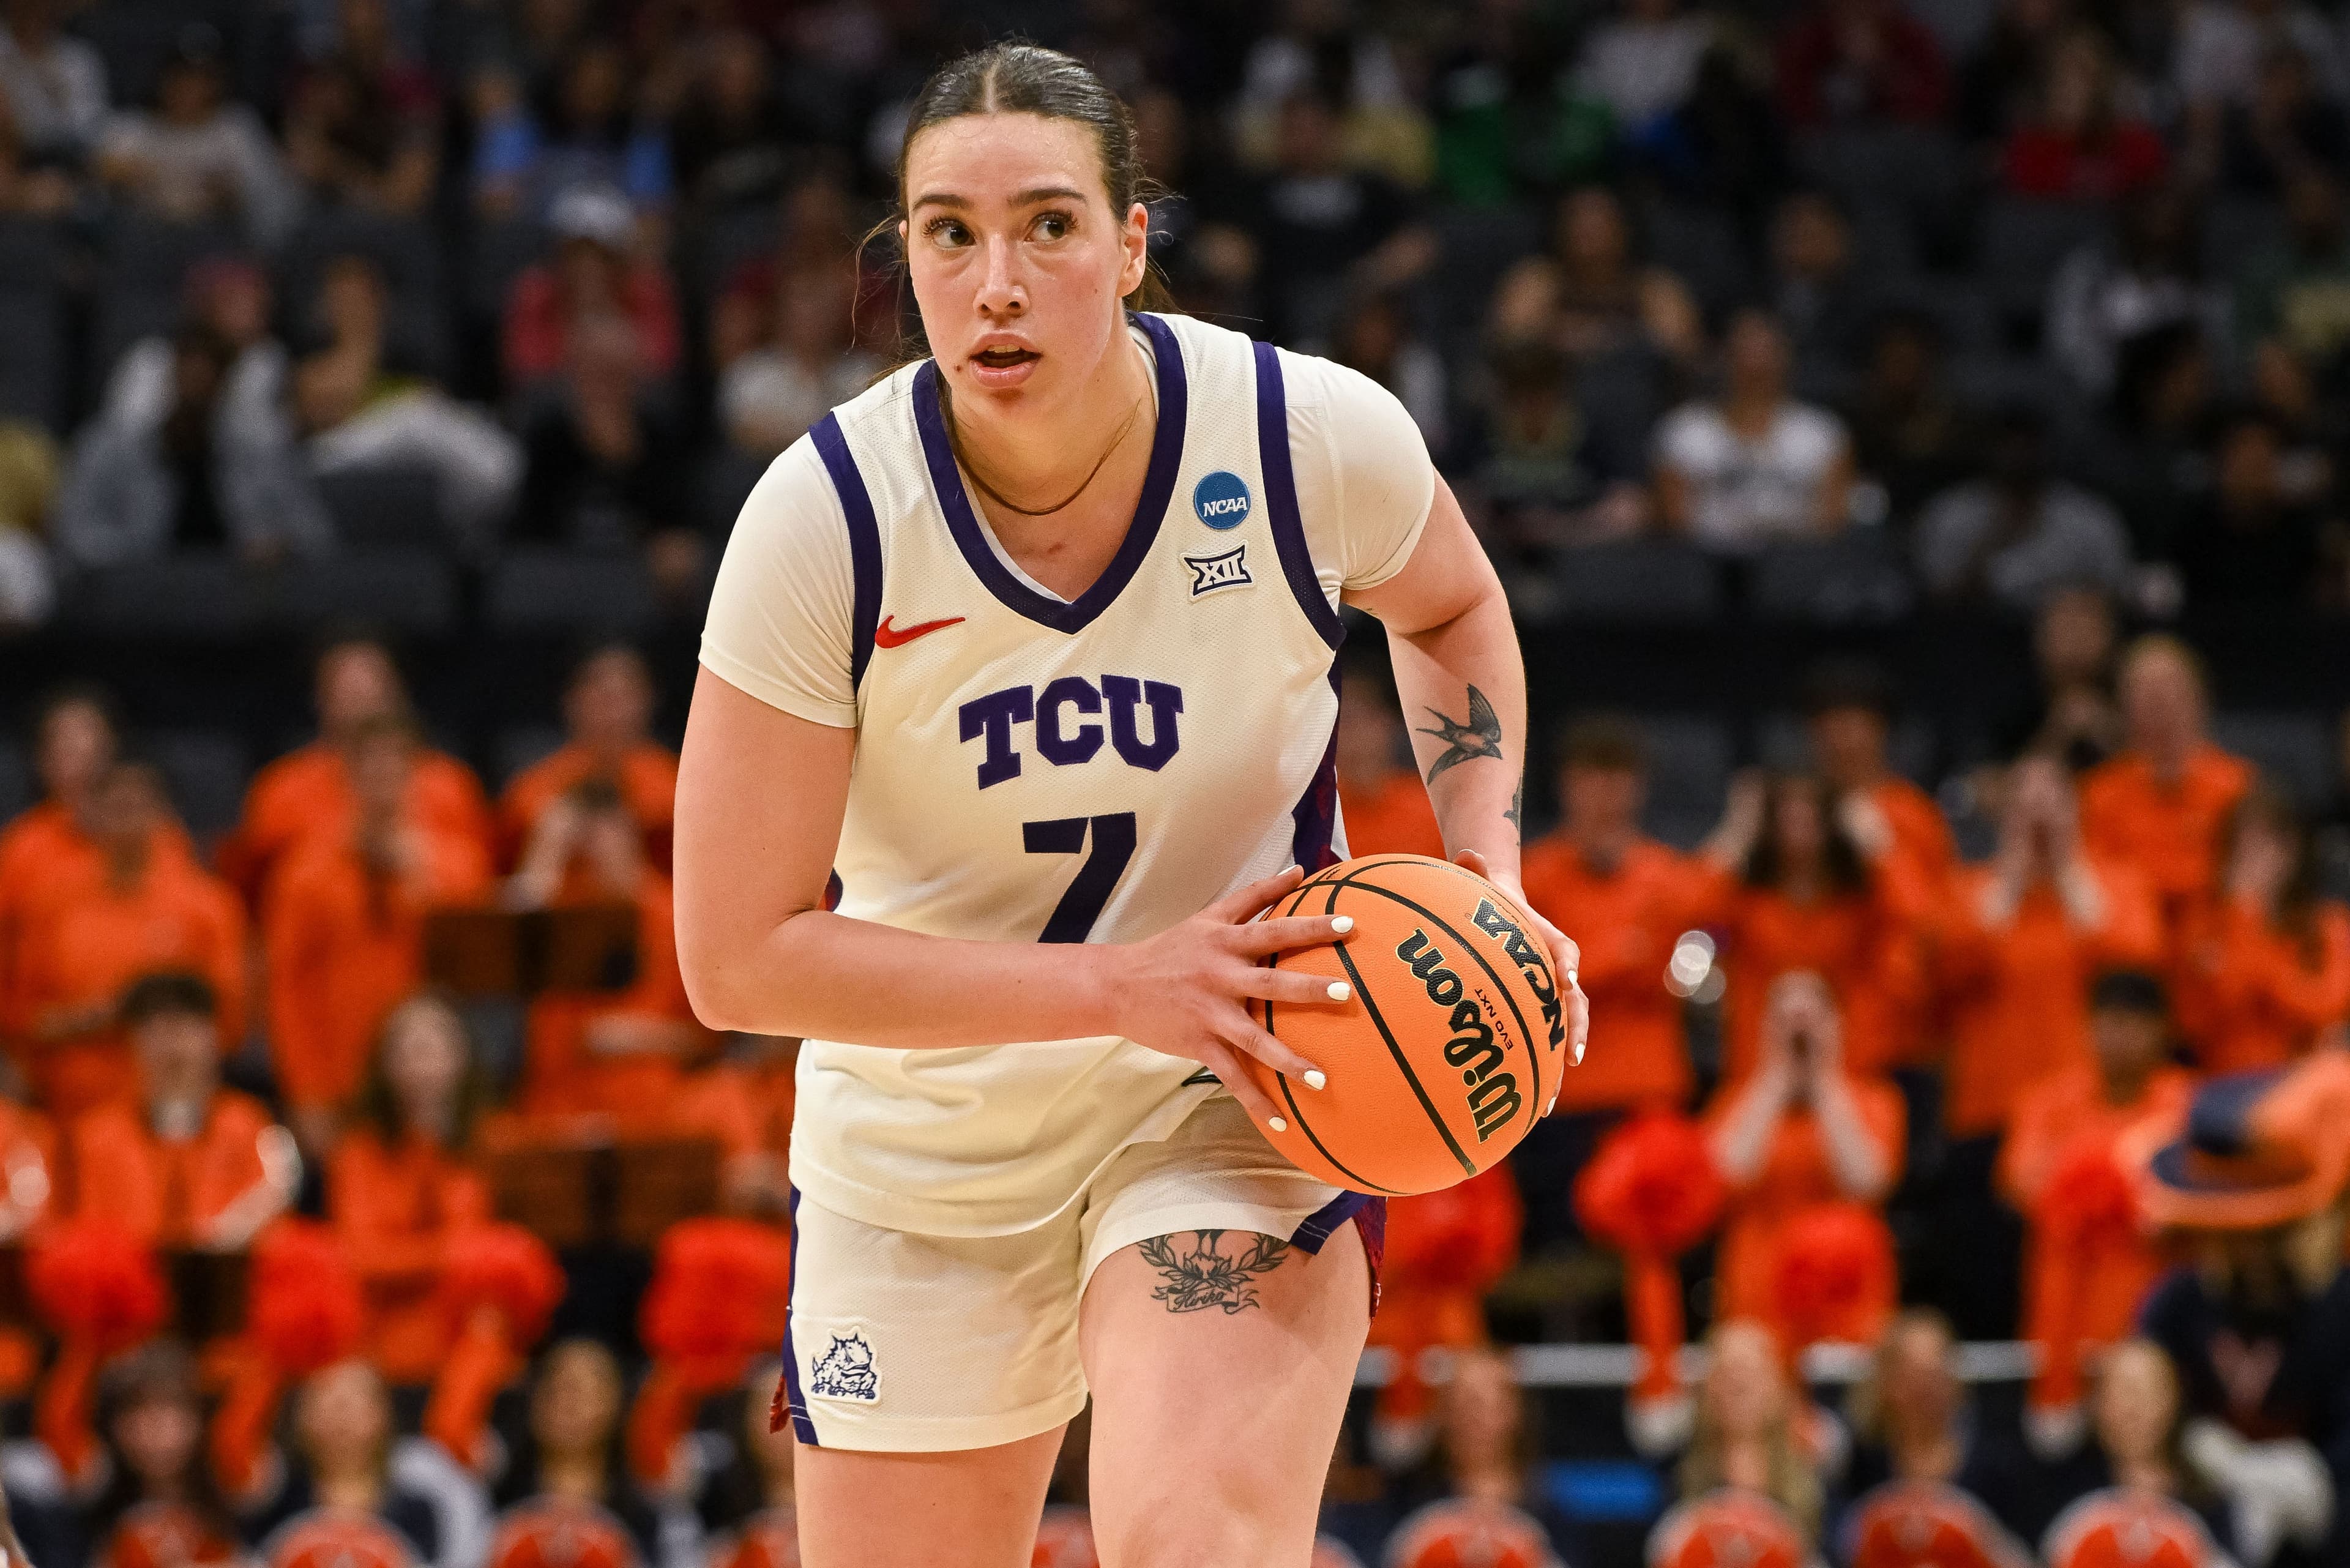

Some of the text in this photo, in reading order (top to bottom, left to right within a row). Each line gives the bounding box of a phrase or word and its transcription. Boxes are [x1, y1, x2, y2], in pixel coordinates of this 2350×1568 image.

[1203, 496, 1248, 517] NCAA
[1190, 550, 1248, 591] XII
[958, 674, 1184, 791] TCU
[1022, 811, 1137, 944] 7
[1471, 897, 1565, 1051] NCAA
[1474, 987, 1514, 1051] EVO NXT
[1396, 928, 1522, 1144] Wilson
